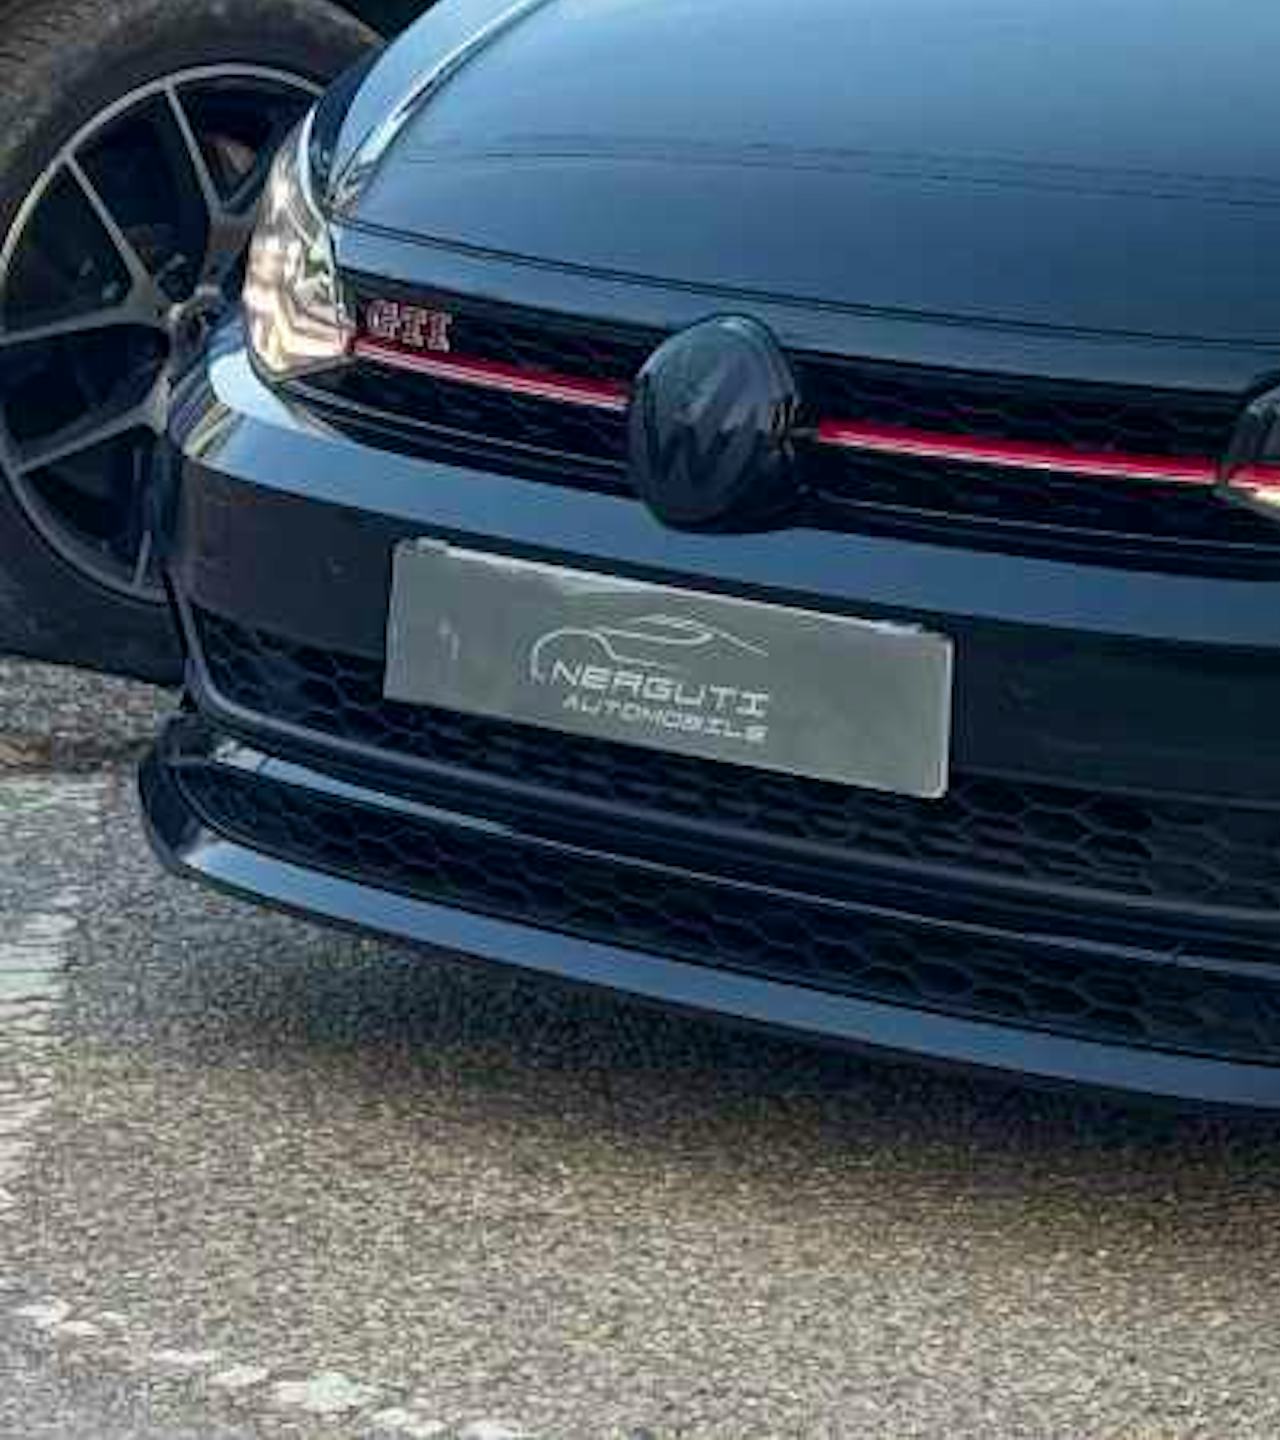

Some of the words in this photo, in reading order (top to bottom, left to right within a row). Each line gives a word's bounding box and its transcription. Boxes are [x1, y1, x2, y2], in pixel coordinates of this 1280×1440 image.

[366, 299, 453, 353] GTI
[551, 659, 770, 719] NERGUTI
[562, 693, 769, 744] AUTOMOBILE
